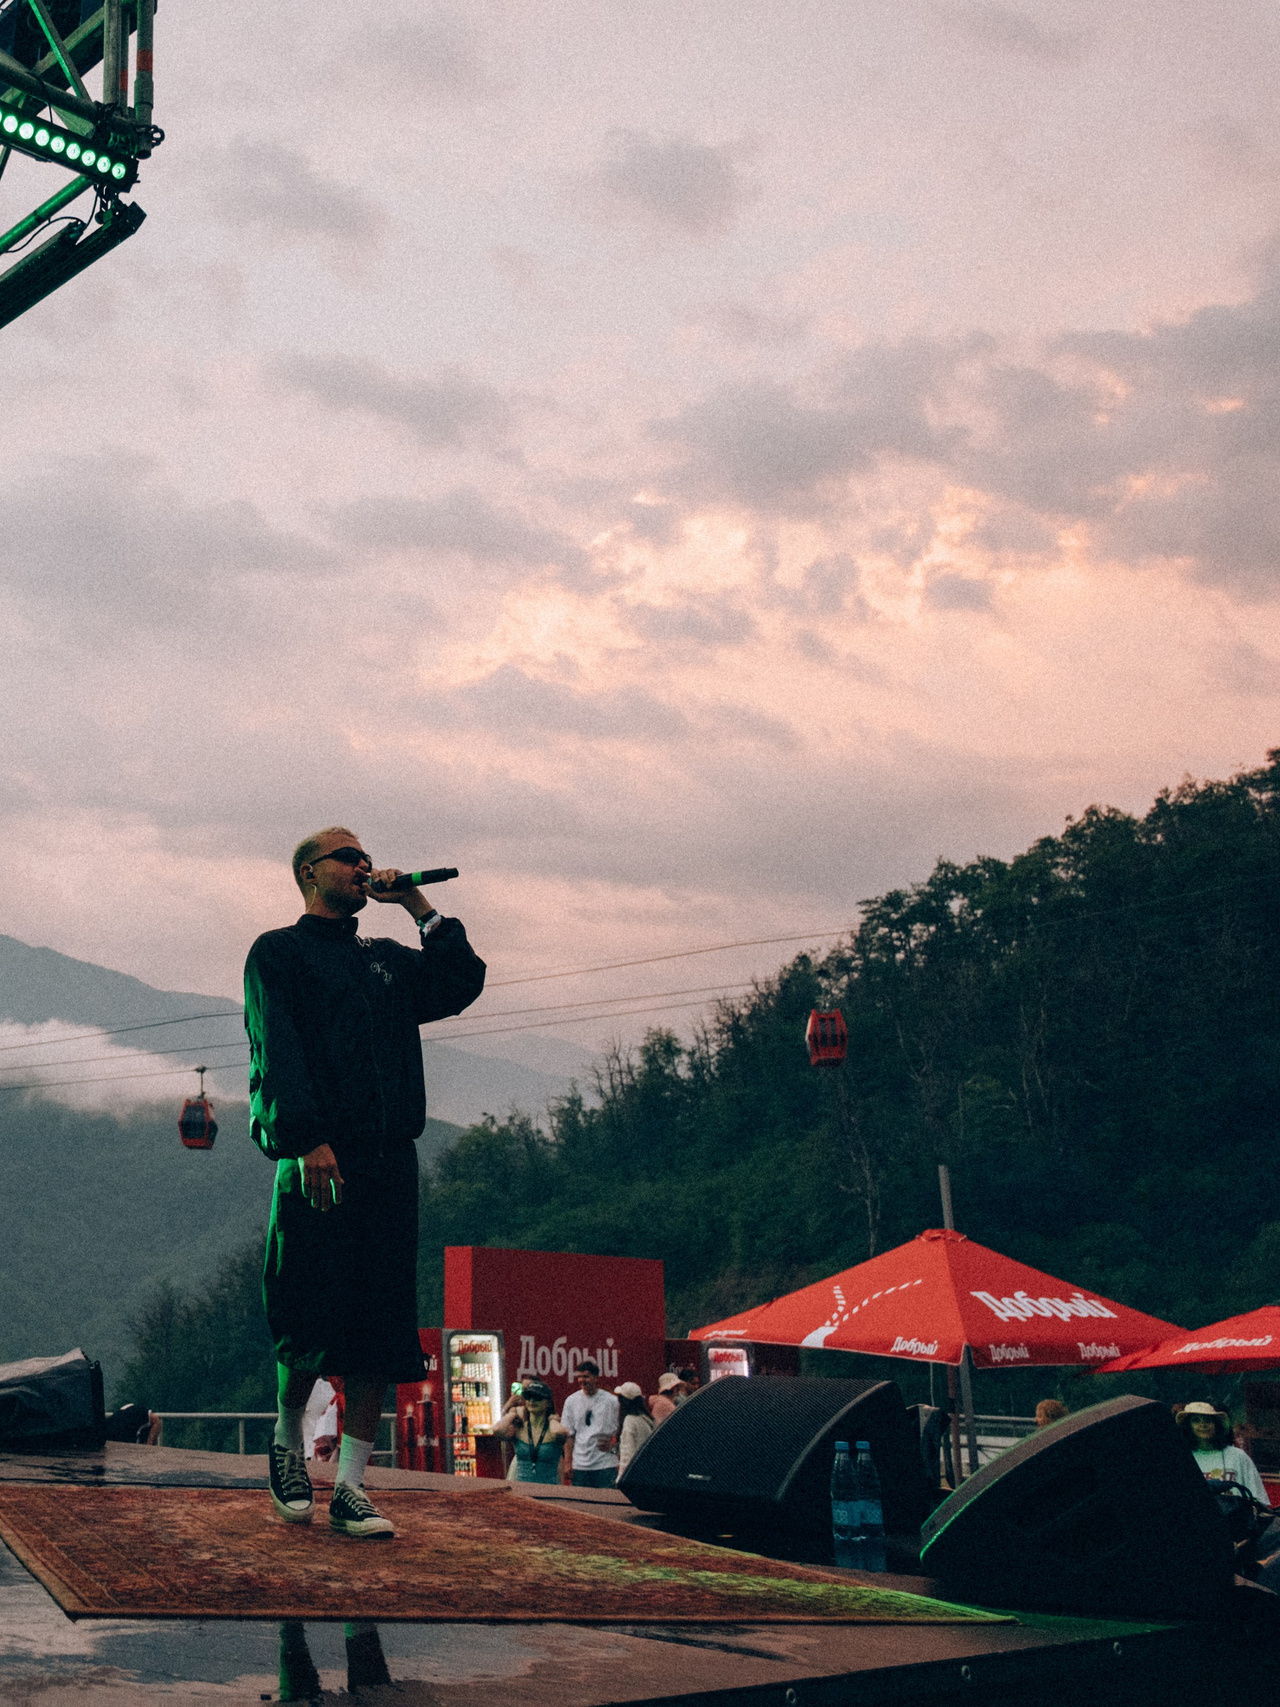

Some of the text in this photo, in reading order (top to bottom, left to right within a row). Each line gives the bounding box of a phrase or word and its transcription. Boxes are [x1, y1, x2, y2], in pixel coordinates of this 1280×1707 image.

[970, 1291, 1118, 1322] Добрый
[890, 1336, 939, 1355] Добрый
[989, 1343, 1030, 1362] Добрый
[1077, 1342, 1121, 1360] Добрый
